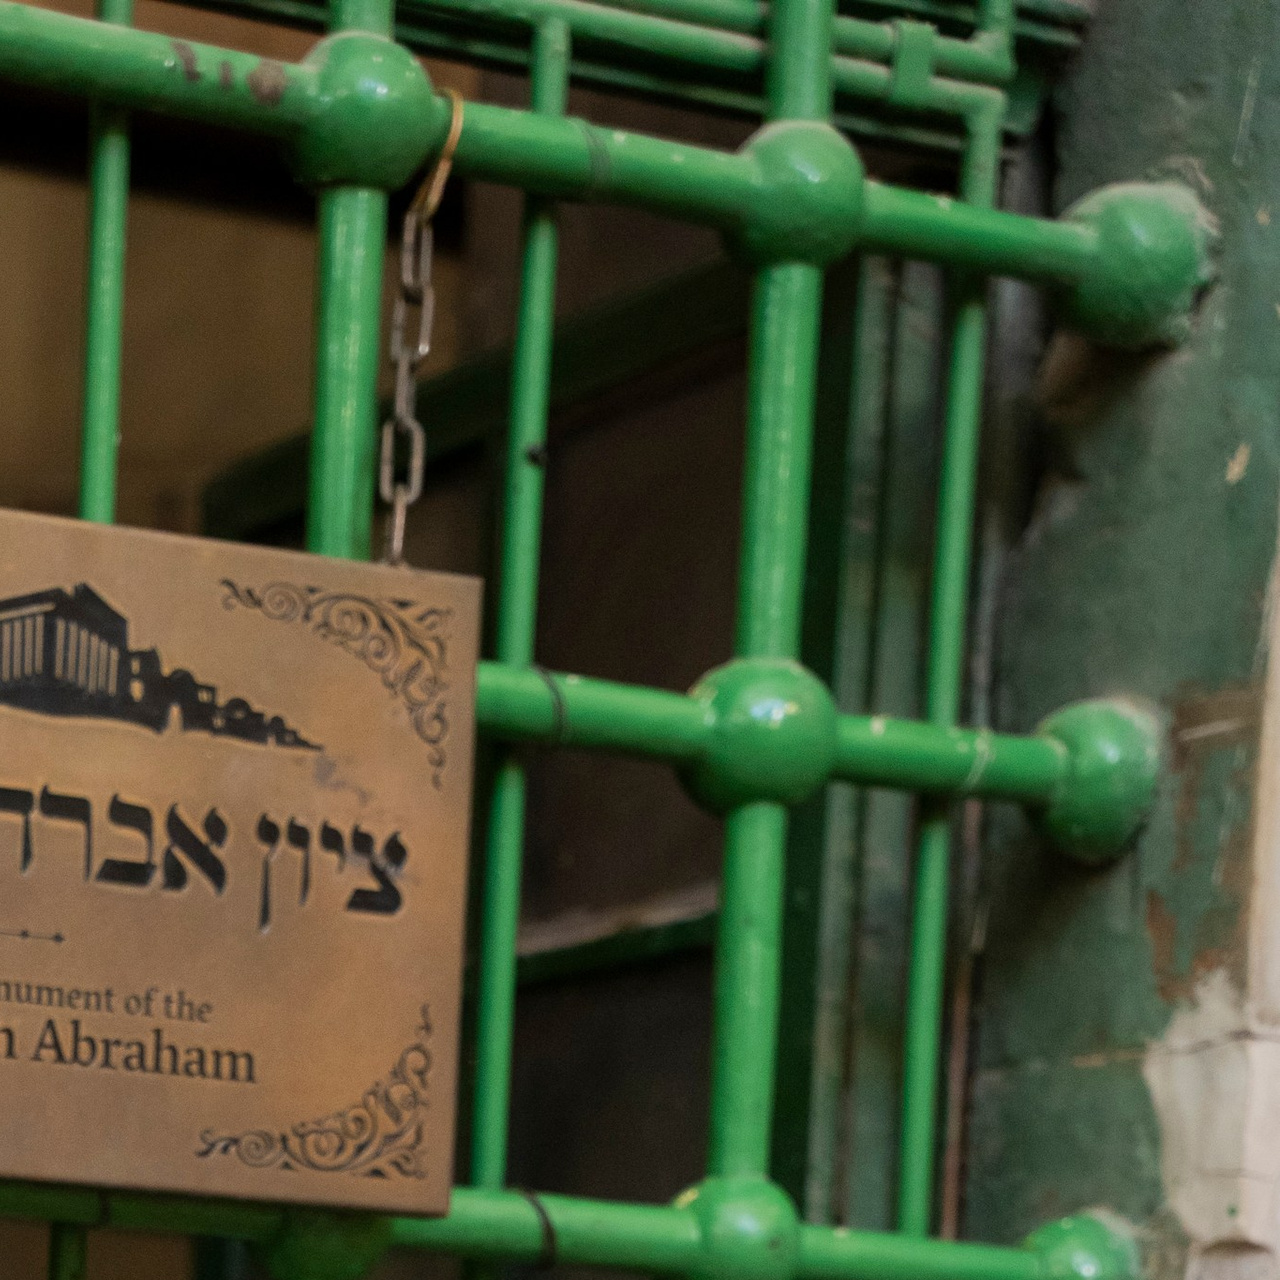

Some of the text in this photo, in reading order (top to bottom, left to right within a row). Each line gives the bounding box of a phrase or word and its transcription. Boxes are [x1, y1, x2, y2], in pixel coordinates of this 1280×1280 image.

[254, 812, 410, 932] ציון
[123, 987, 157, 1017] of
[163, 990, 214, 1023] the
[30, 1018, 258, 1084] Abraham
